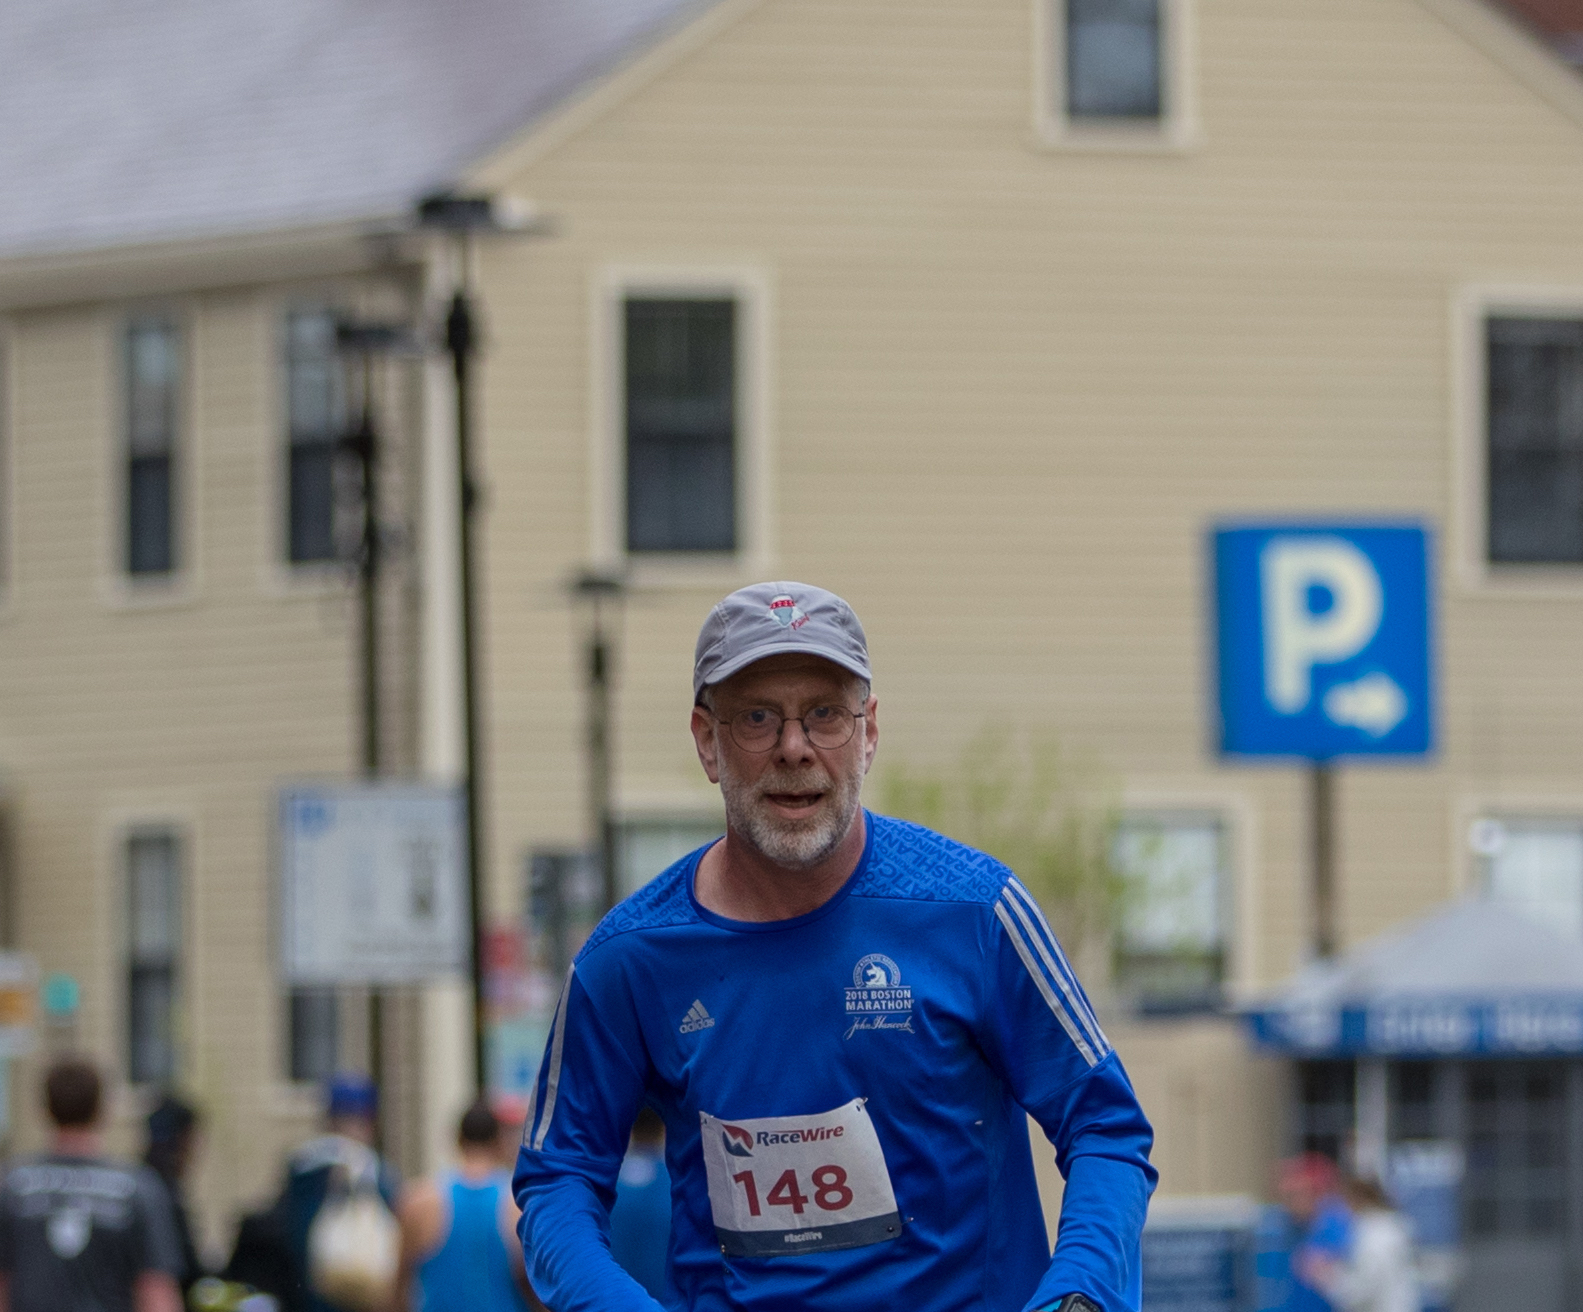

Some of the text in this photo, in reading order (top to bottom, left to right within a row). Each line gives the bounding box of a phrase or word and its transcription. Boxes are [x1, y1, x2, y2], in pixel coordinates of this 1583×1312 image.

[1259, 536, 1385, 715] P
[845, 989, 911, 1000] 2018 BOSTON
[845, 1000, 912, 1010] MARATHON
[679, 1017, 716, 1034] adidas
[756, 1125, 844, 1147] RaceWire
[732, 1164, 854, 1217] 148
